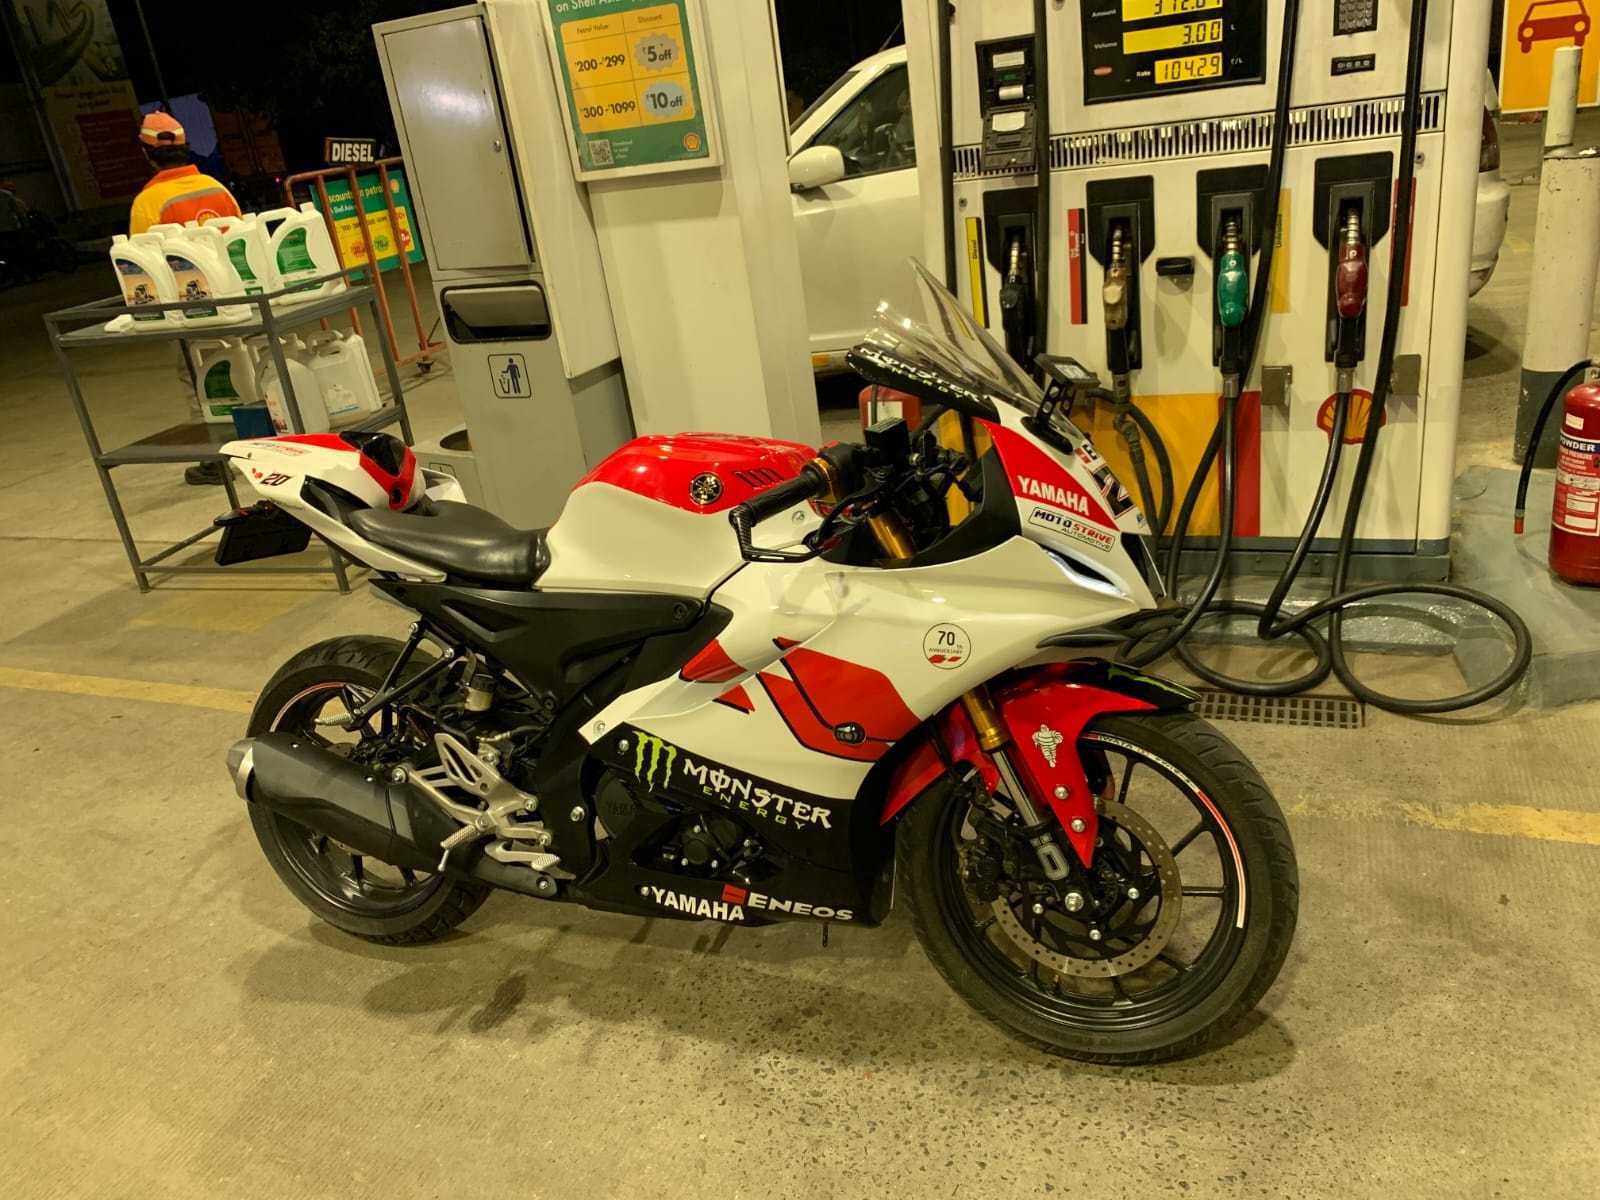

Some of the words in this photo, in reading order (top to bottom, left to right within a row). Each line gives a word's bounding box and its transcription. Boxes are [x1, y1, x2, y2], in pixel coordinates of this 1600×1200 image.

[556, 5, 569, 13] on
[1092, 9, 1116, 18] Amount
[1094, 41, 1118, 50] Volume
[1182, 21, 1221, 45] 3.00
[659, 49, 672, 61] off
[1164, 55, 1221, 81] 104.29
[670, 96, 683, 108] off
[332, 143, 375, 162] DIESEL
[365, 185, 383, 199] petro
[1017, 474, 1090, 516] YAMAHA
[1034, 510, 1072, 528] MOTO
[1072, 523, 1113, 544] STRIVE
[1060, 527, 1111, 550] AUTOMOTIVE
[937, 630, 956, 647] 70
[683, 758, 832, 830] MONSTER
[703, 785, 805, 830] ENERGY
[651, 885, 745, 921] YAMAHA
[747, 892, 855, 921] ENEOS
